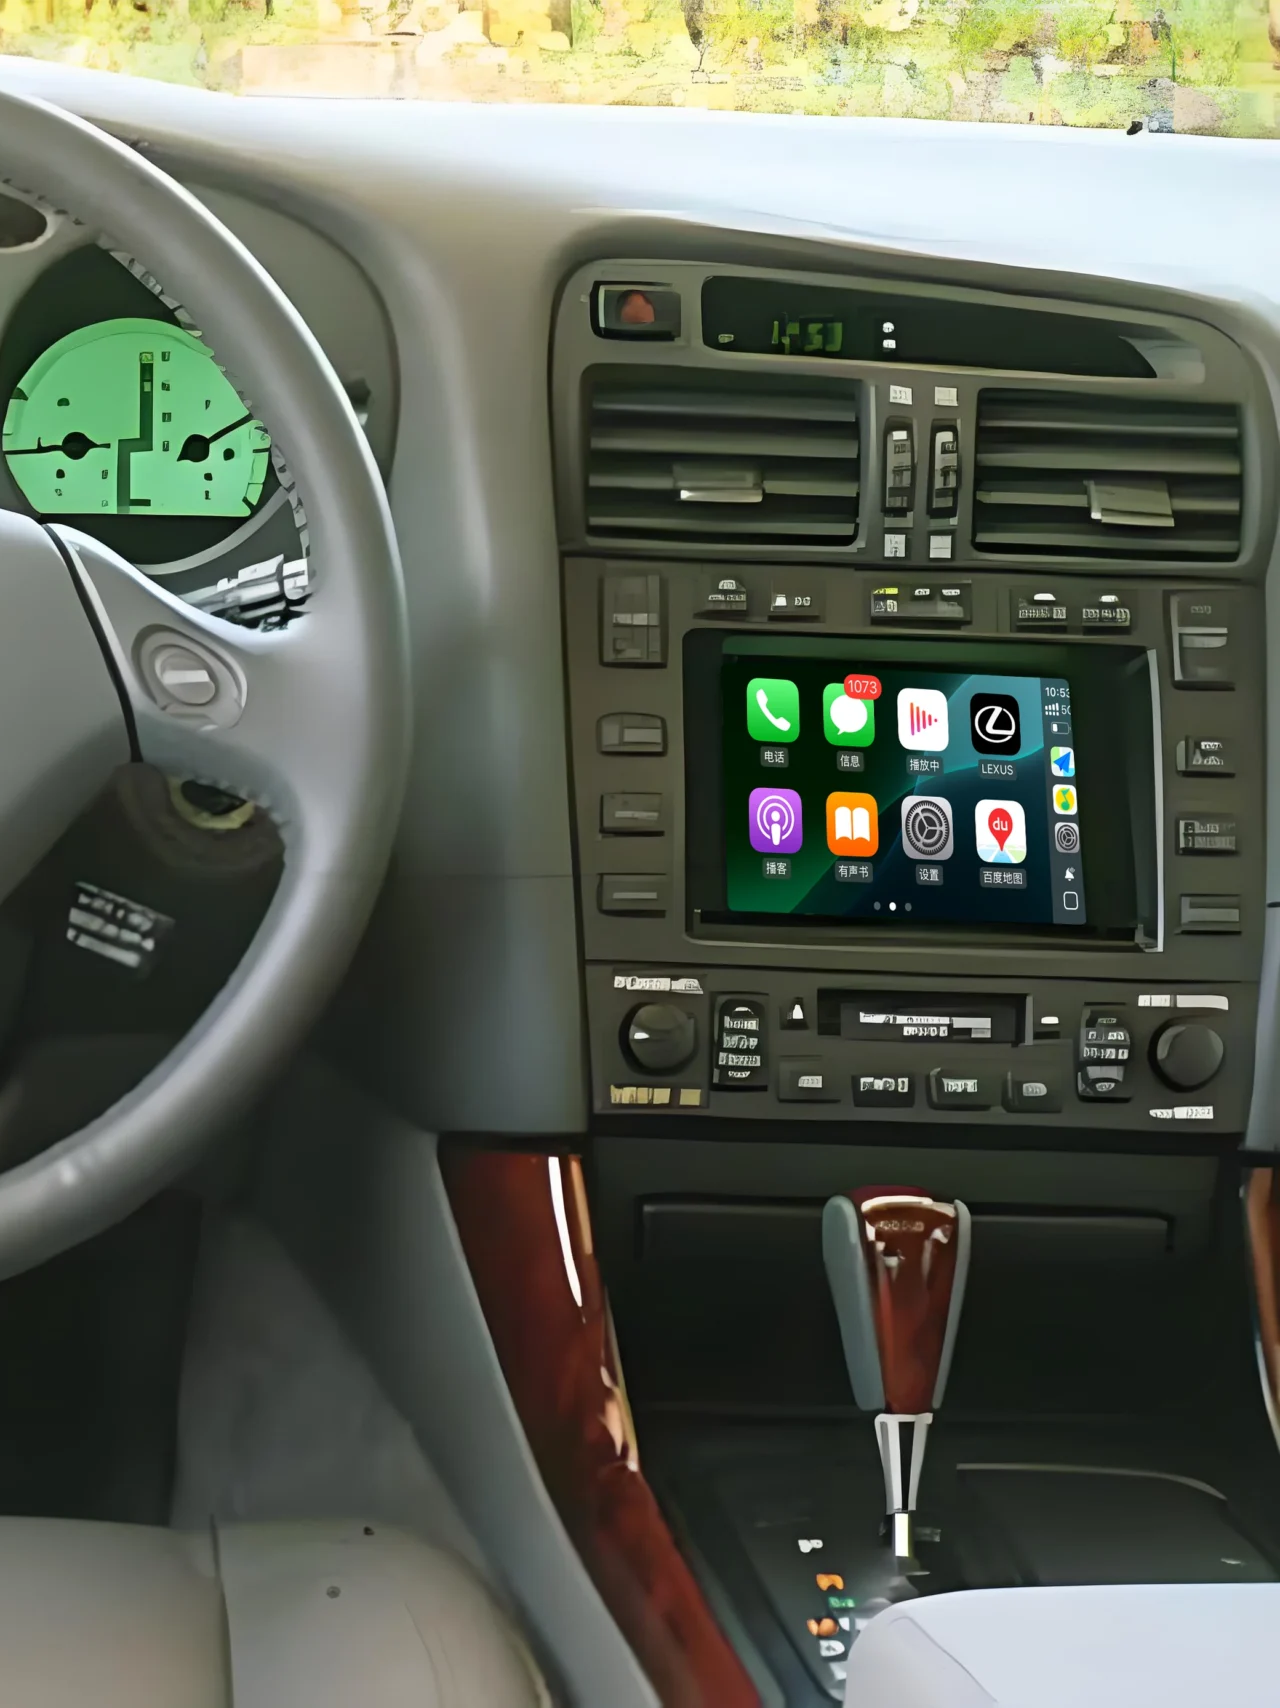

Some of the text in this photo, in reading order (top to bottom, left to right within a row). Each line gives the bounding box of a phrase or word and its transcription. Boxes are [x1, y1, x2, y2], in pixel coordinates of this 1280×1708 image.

[848, 680, 877, 694] 1073
[764, 750, 785, 763] 电话
[840, 754, 860, 768] 信息
[909, 758, 940, 772] 播放中
[981, 764, 1014, 776] LEXUS
[992, 816, 1008, 831] du
[766, 862, 787, 875] 播客
[838, 865, 869, 878] 有声书
[919, 868, 939, 881] 设置
[983, 871, 1023, 885] 百度地图
